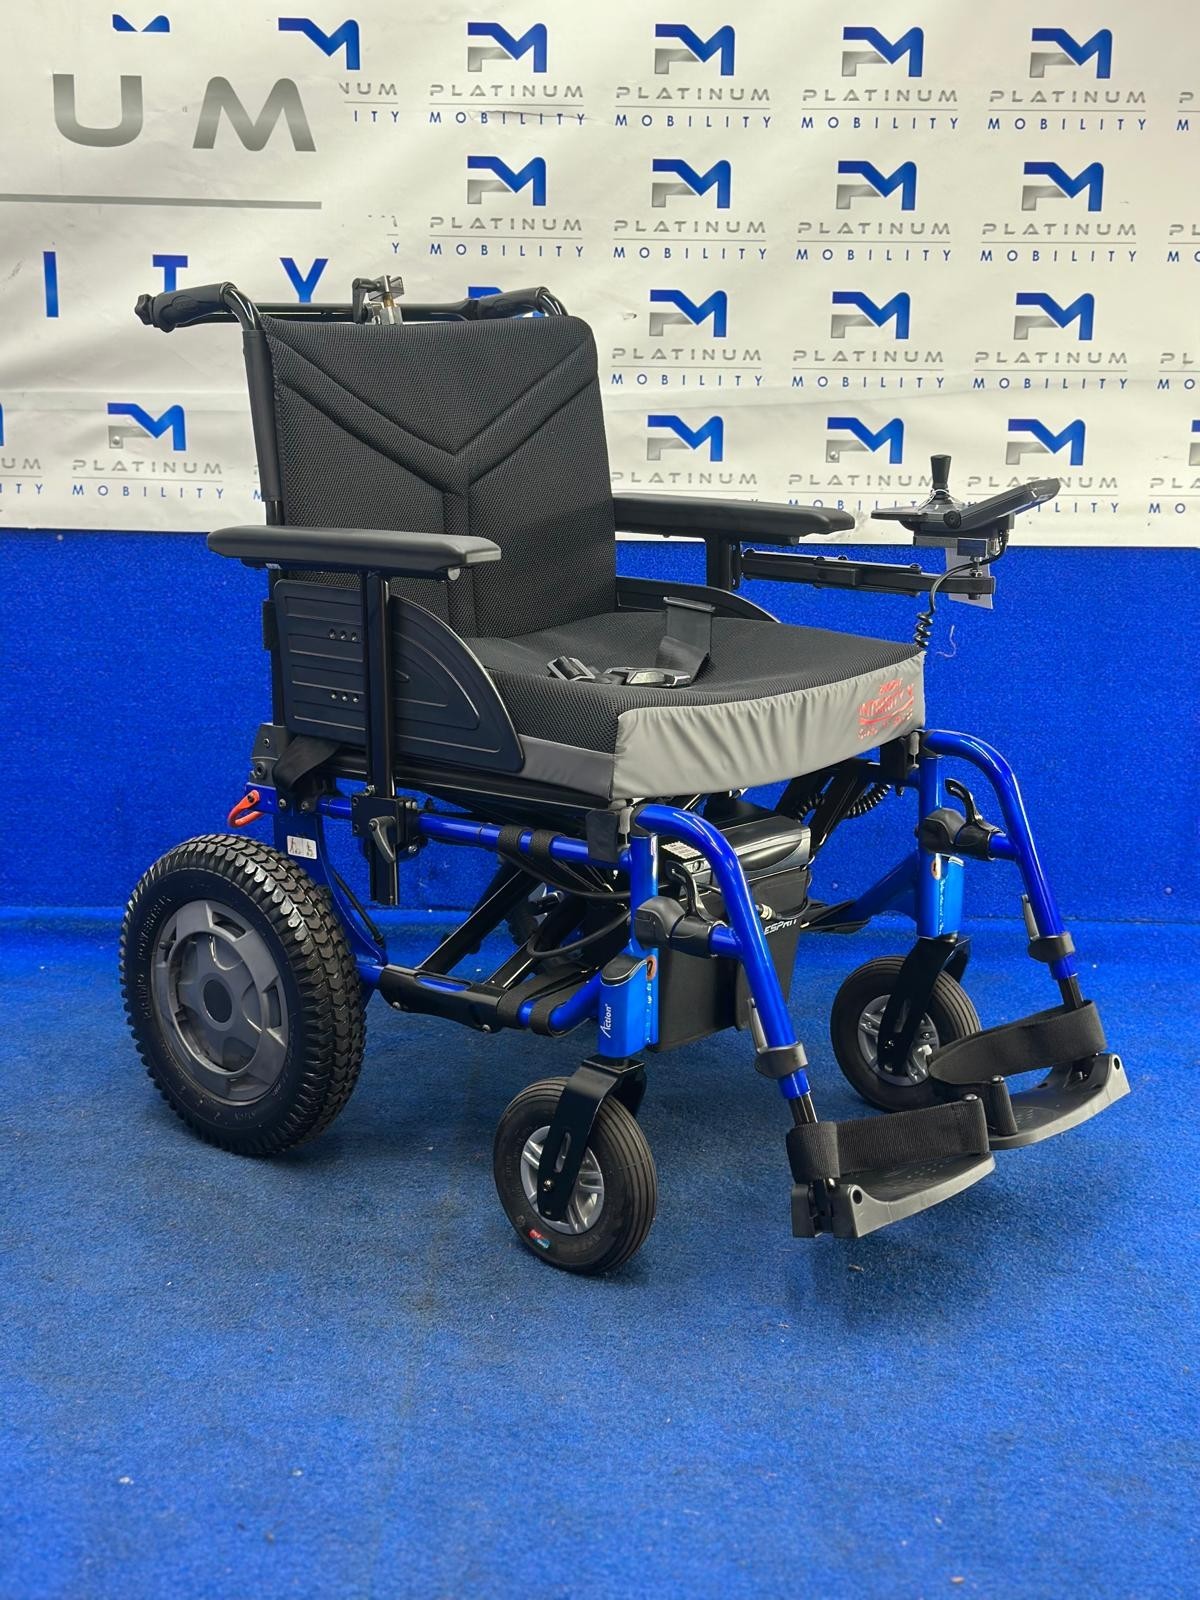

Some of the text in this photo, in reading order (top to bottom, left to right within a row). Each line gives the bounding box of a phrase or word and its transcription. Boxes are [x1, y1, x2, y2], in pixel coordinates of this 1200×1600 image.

[430, 84, 583, 98] PLATINUM
[616, 87, 770, 101] PLATINUM
[803, 89, 957, 102] PLATINUM
[990, 90, 1146, 103] PLATINUM
[430, 111, 584, 125] MOBILITY
[615, 114, 770, 128] MOBILITY
[802, 117, 958, 129] MOBILITY
[988, 118, 1146, 130] MOBILITY
[430, 217, 581, 231] PLATINUM
[614, 220, 765, 233] PLATINUM
[798, 222, 950, 234] PLATINUM
[982, 223, 1136, 235] PLATINUM
[430, 244, 583, 257] MOBILITY
[614, 247, 766, 259] MOBILITY
[796, 249, 950, 261] MOBILITY
[980, 250, 1136, 262] MOBILITY
[612, 348, 761, 361] PLATINUM
[793, 350, 943, 362] PLATINUM
[975, 352, 1127, 364] PLATINUM
[612, 374, 762, 386] MOBILITY
[792, 376, 944, 388] MOBILITY
[973, 378, 1127, 389] MOBILITY
[72, 459, 222, 474] PLATINUM
[611, 472, 757, 484] PLATINUM
[789, 472, 933, 486] PLATINUM
[72, 485, 223, 499] MOBILITY
